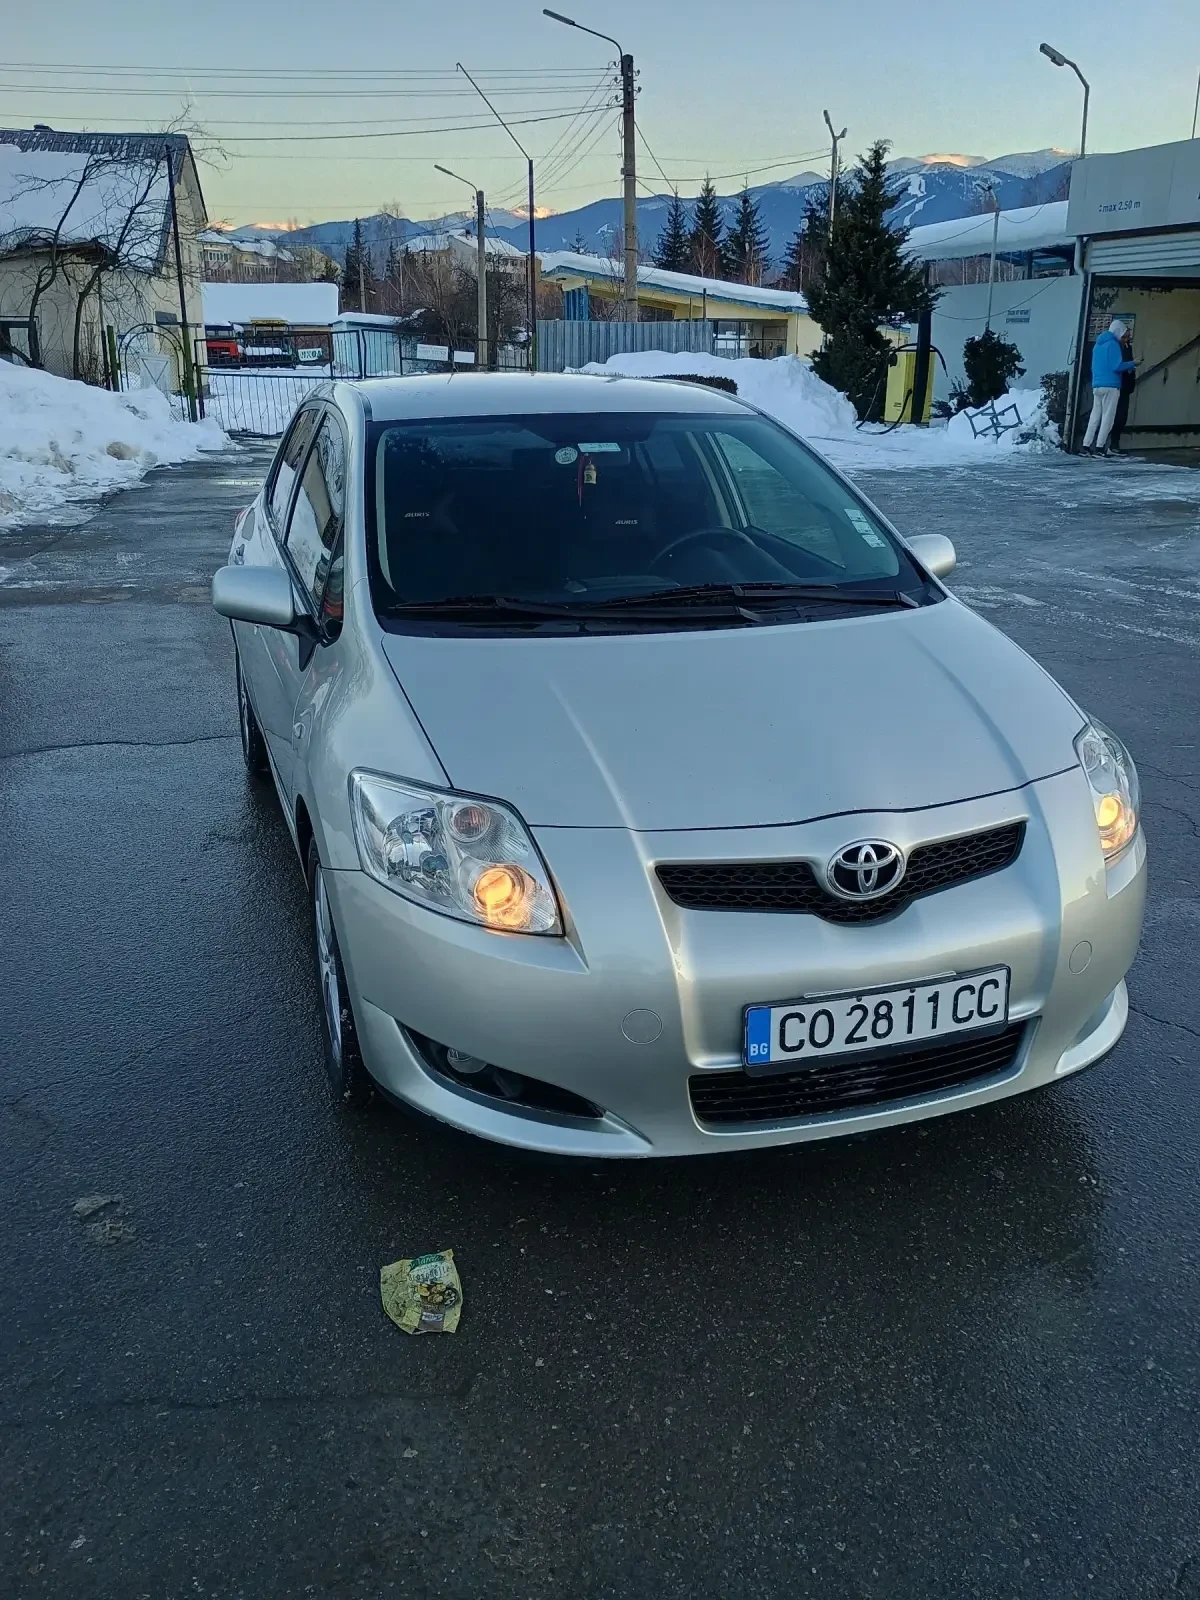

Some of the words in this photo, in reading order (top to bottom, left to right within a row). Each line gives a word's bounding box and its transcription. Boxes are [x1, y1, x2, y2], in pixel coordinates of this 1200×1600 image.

[1102, 204, 1117, 213] max
[1118, 200, 1133, 211] 2.50
[1133, 201, 1141, 209] m
[779, 1008, 835, 1053] CO
[844, 990, 940, 1045] 2811
[952, 978, 1000, 1024] CC
[750, 1043, 768, 1057] BG
